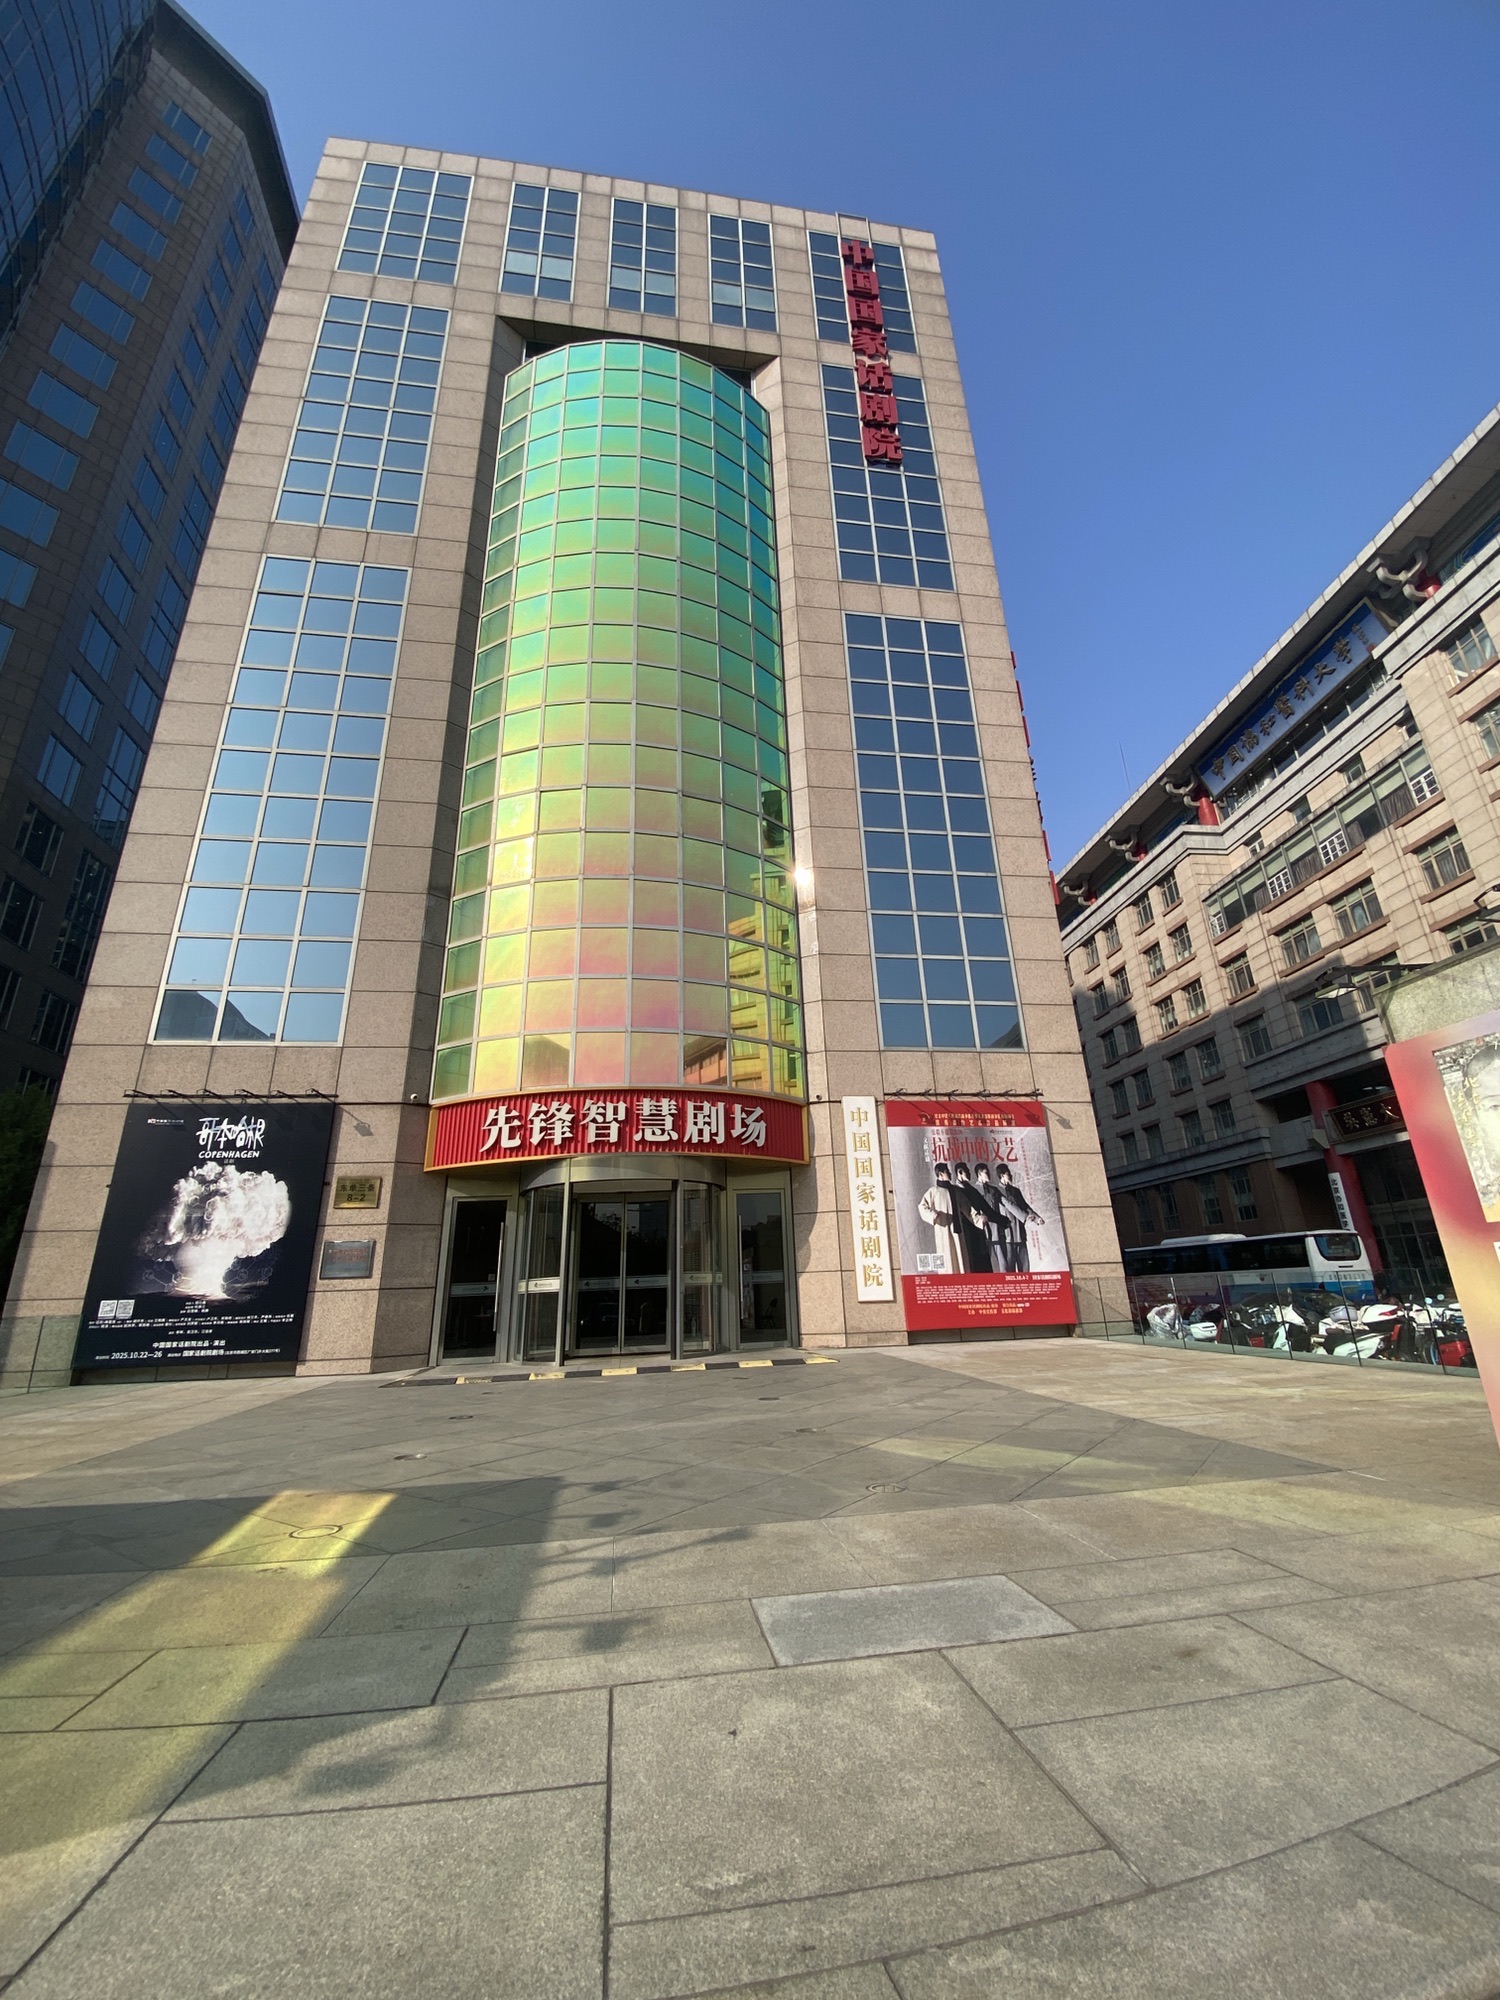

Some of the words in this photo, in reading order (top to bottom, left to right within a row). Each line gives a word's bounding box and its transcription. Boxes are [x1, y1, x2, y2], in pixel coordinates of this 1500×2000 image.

[841, 240, 903, 461] 中国国家话剧院
[480, 1098, 767, 1152] 先锋智慧剧场
[198, 1150, 260, 1158] COPENHAGEN
[932, 1136, 1019, 1163] 抗战中的文艺
[339, 1184, 376, 1192] 东单三条
[346, 1194, 366, 1202] 8-2
[850, 1107, 884, 1287] 中国国家话剧院
